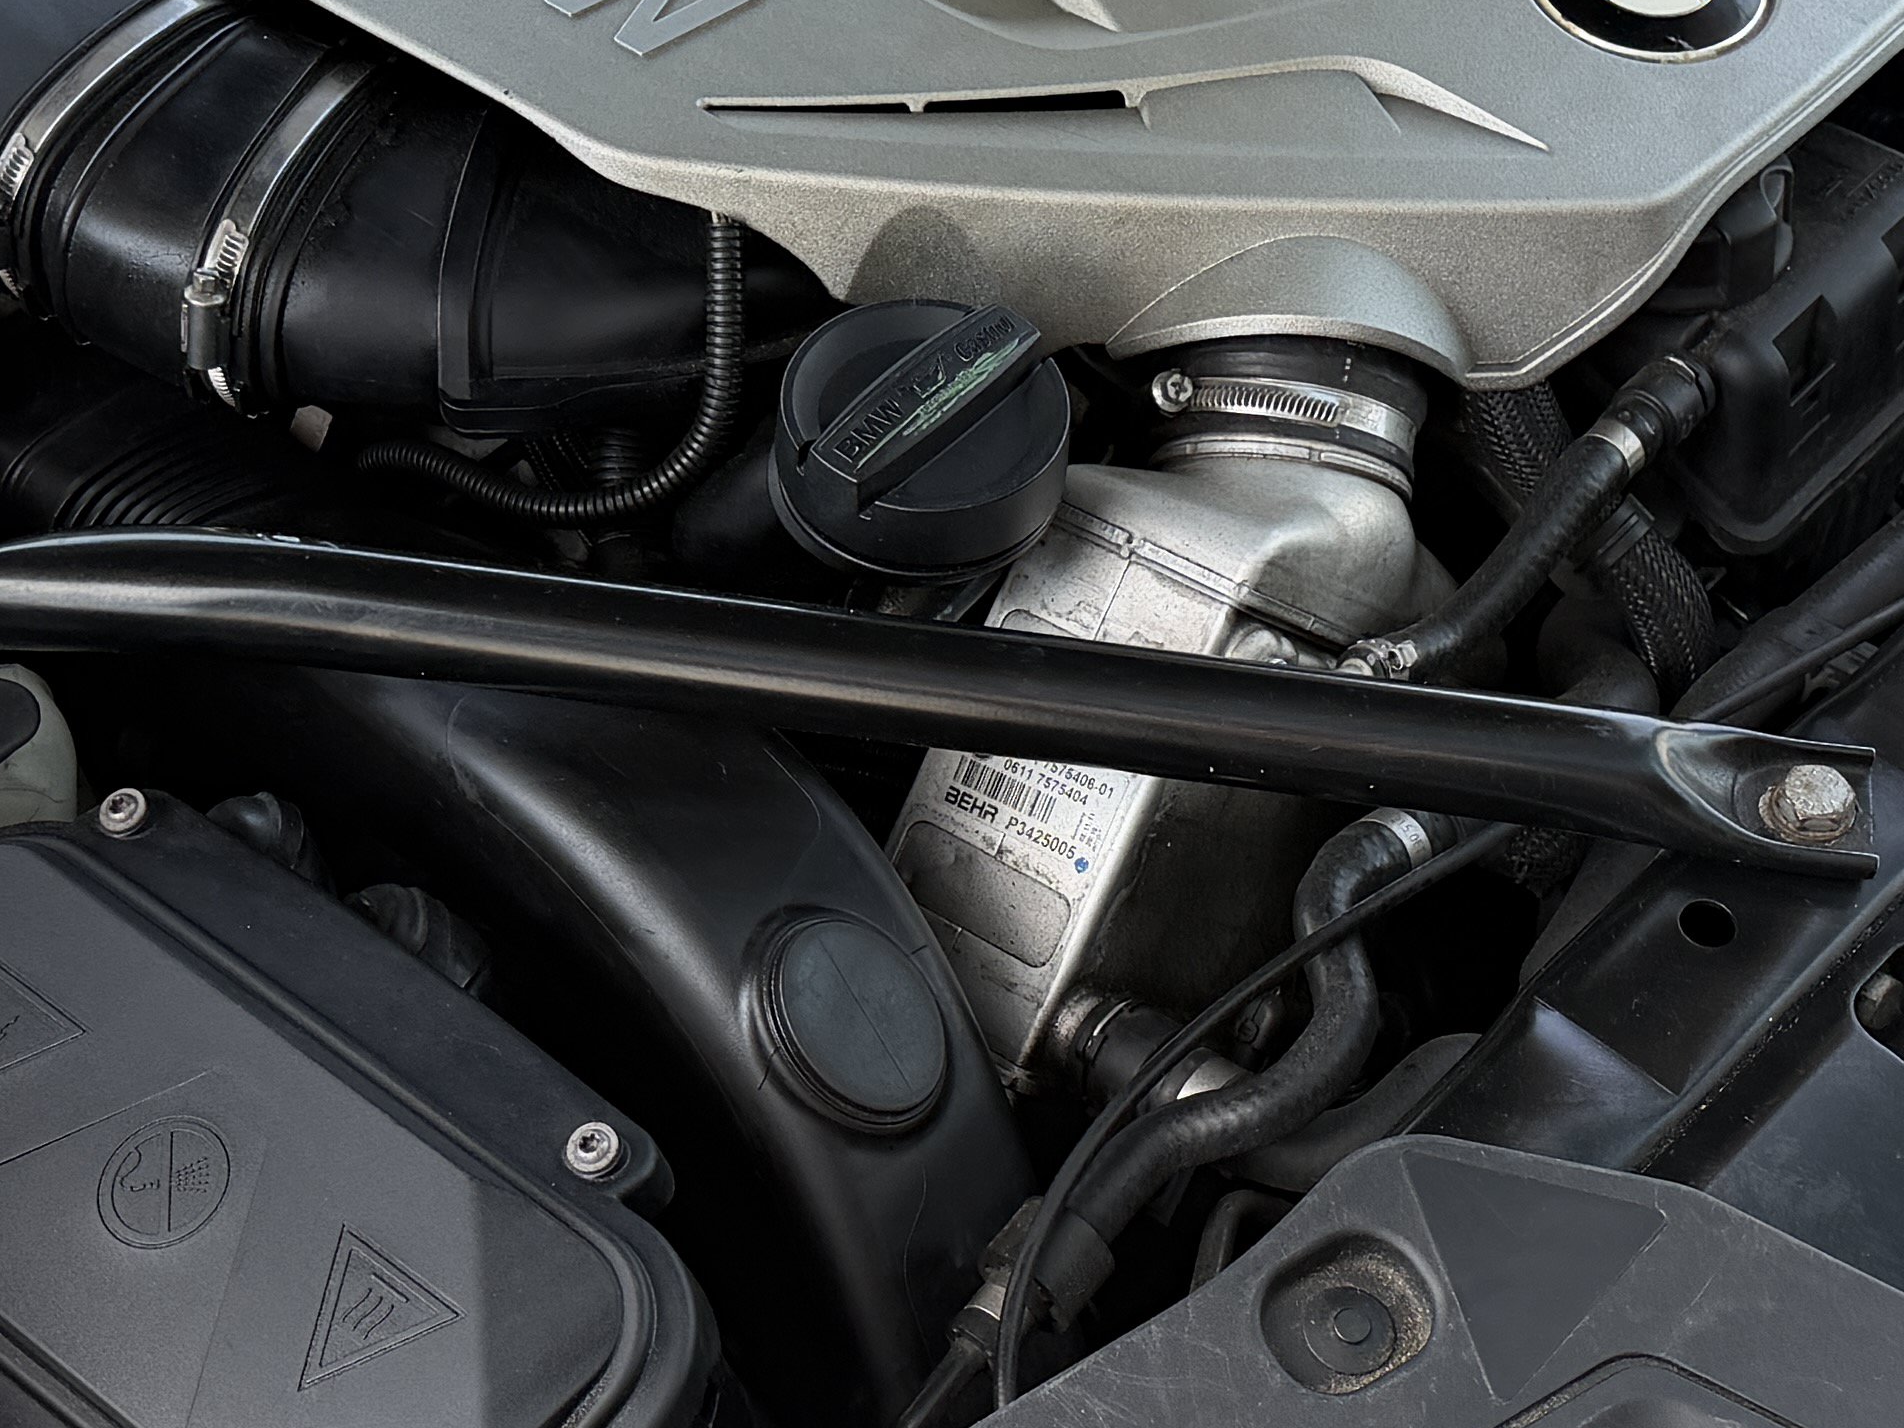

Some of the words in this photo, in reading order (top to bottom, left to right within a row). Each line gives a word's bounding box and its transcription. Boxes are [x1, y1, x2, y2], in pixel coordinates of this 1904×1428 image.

[833, 398, 905, 463] BMW
[954, 314, 1017, 362] Castrol
[1003, 758, 1034, 780] 0611
[1036, 772, 1090, 806] 7575404
[944, 784, 999, 824] BEHR
[1005, 815, 1077, 860] P3425005
